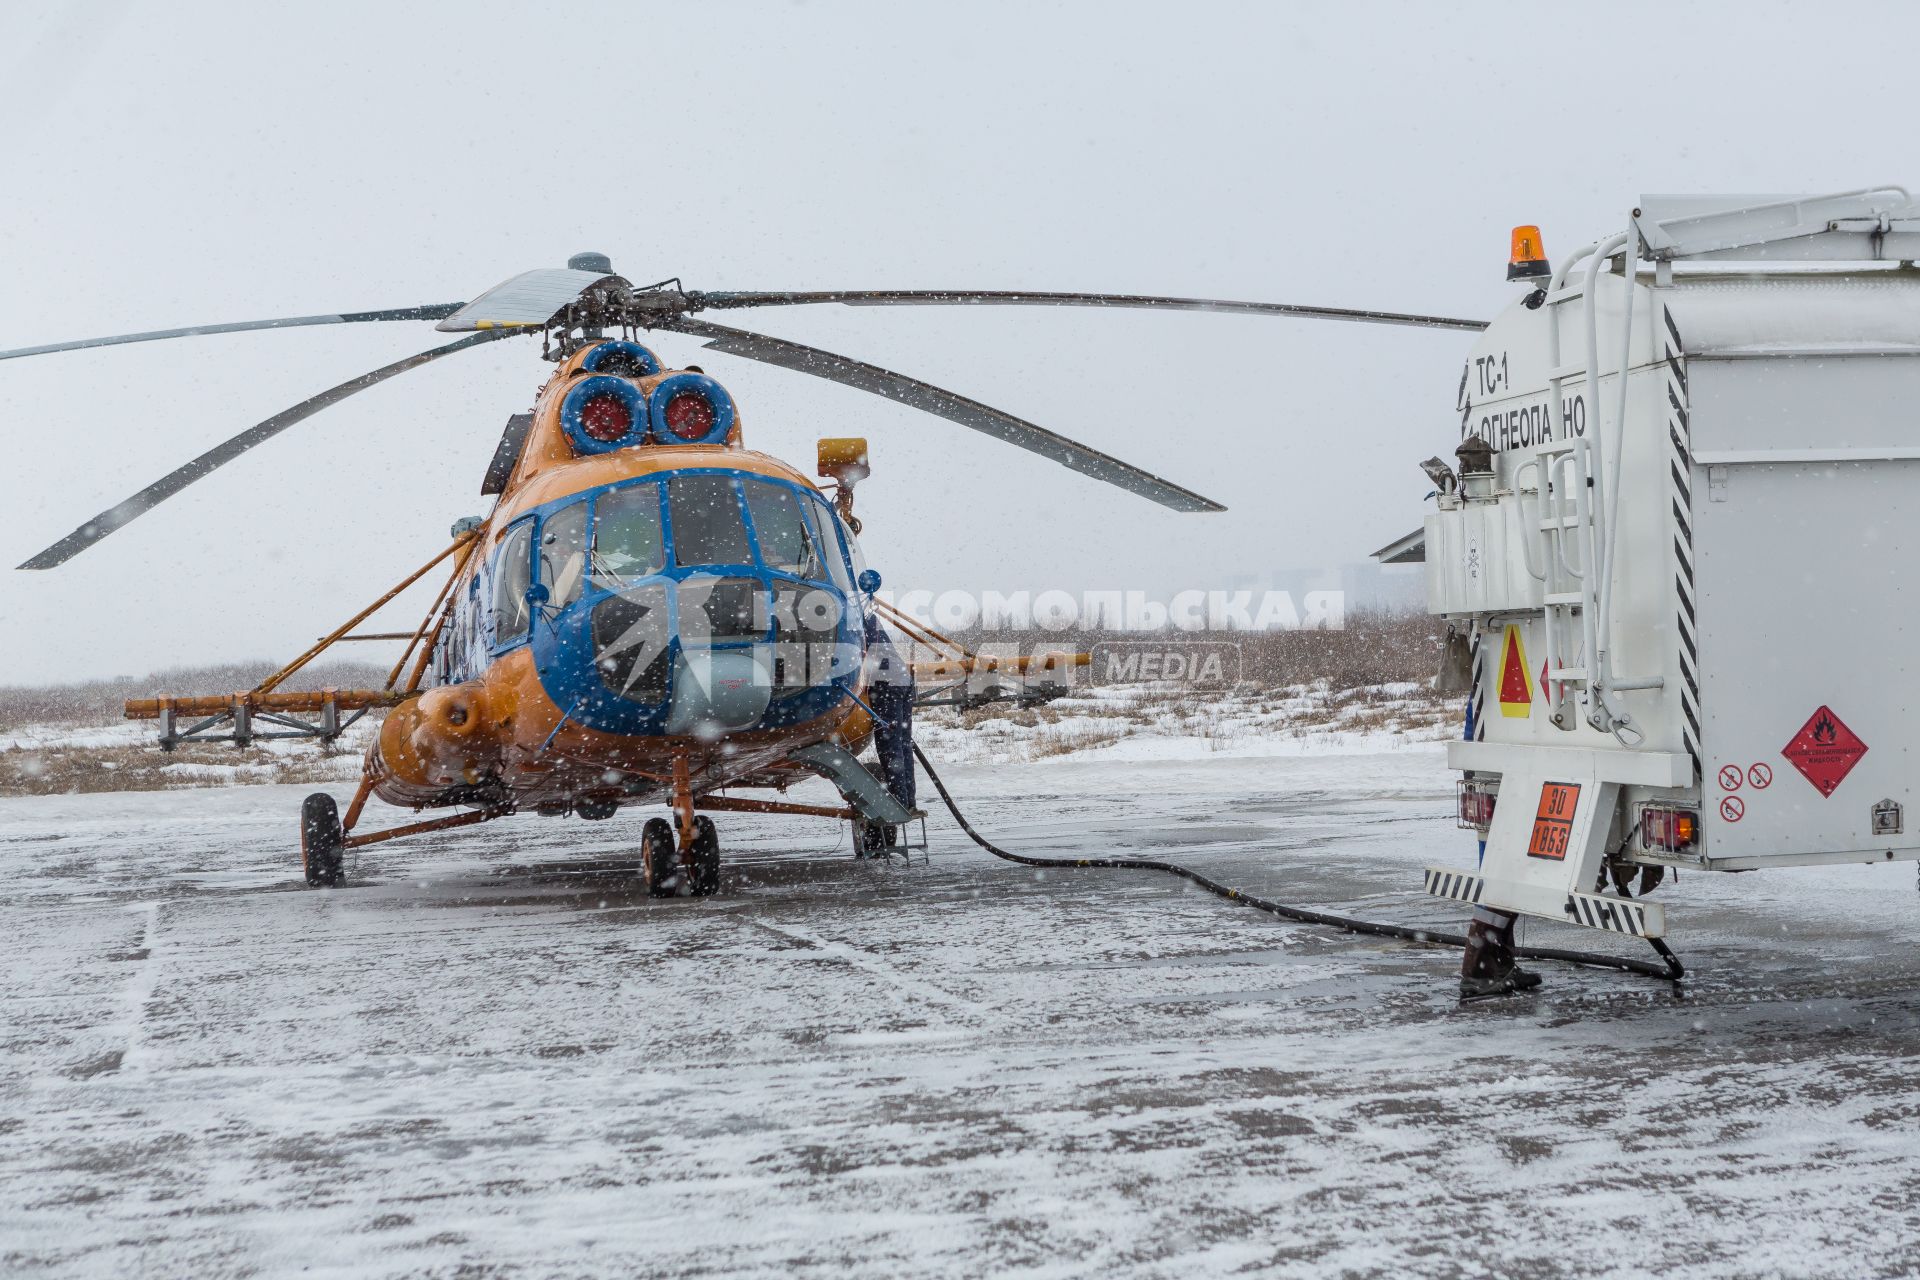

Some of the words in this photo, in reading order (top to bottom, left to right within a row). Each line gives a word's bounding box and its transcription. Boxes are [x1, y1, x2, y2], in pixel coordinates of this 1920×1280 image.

[1476, 351, 1508, 396] ТС-1
[1481, 395, 1585, 452] ОГНЕОПАНО
[1823, 779, 1830, 789] 3
[1548, 788, 1567, 815] 30
[1533, 825, 1567, 854] 1863
